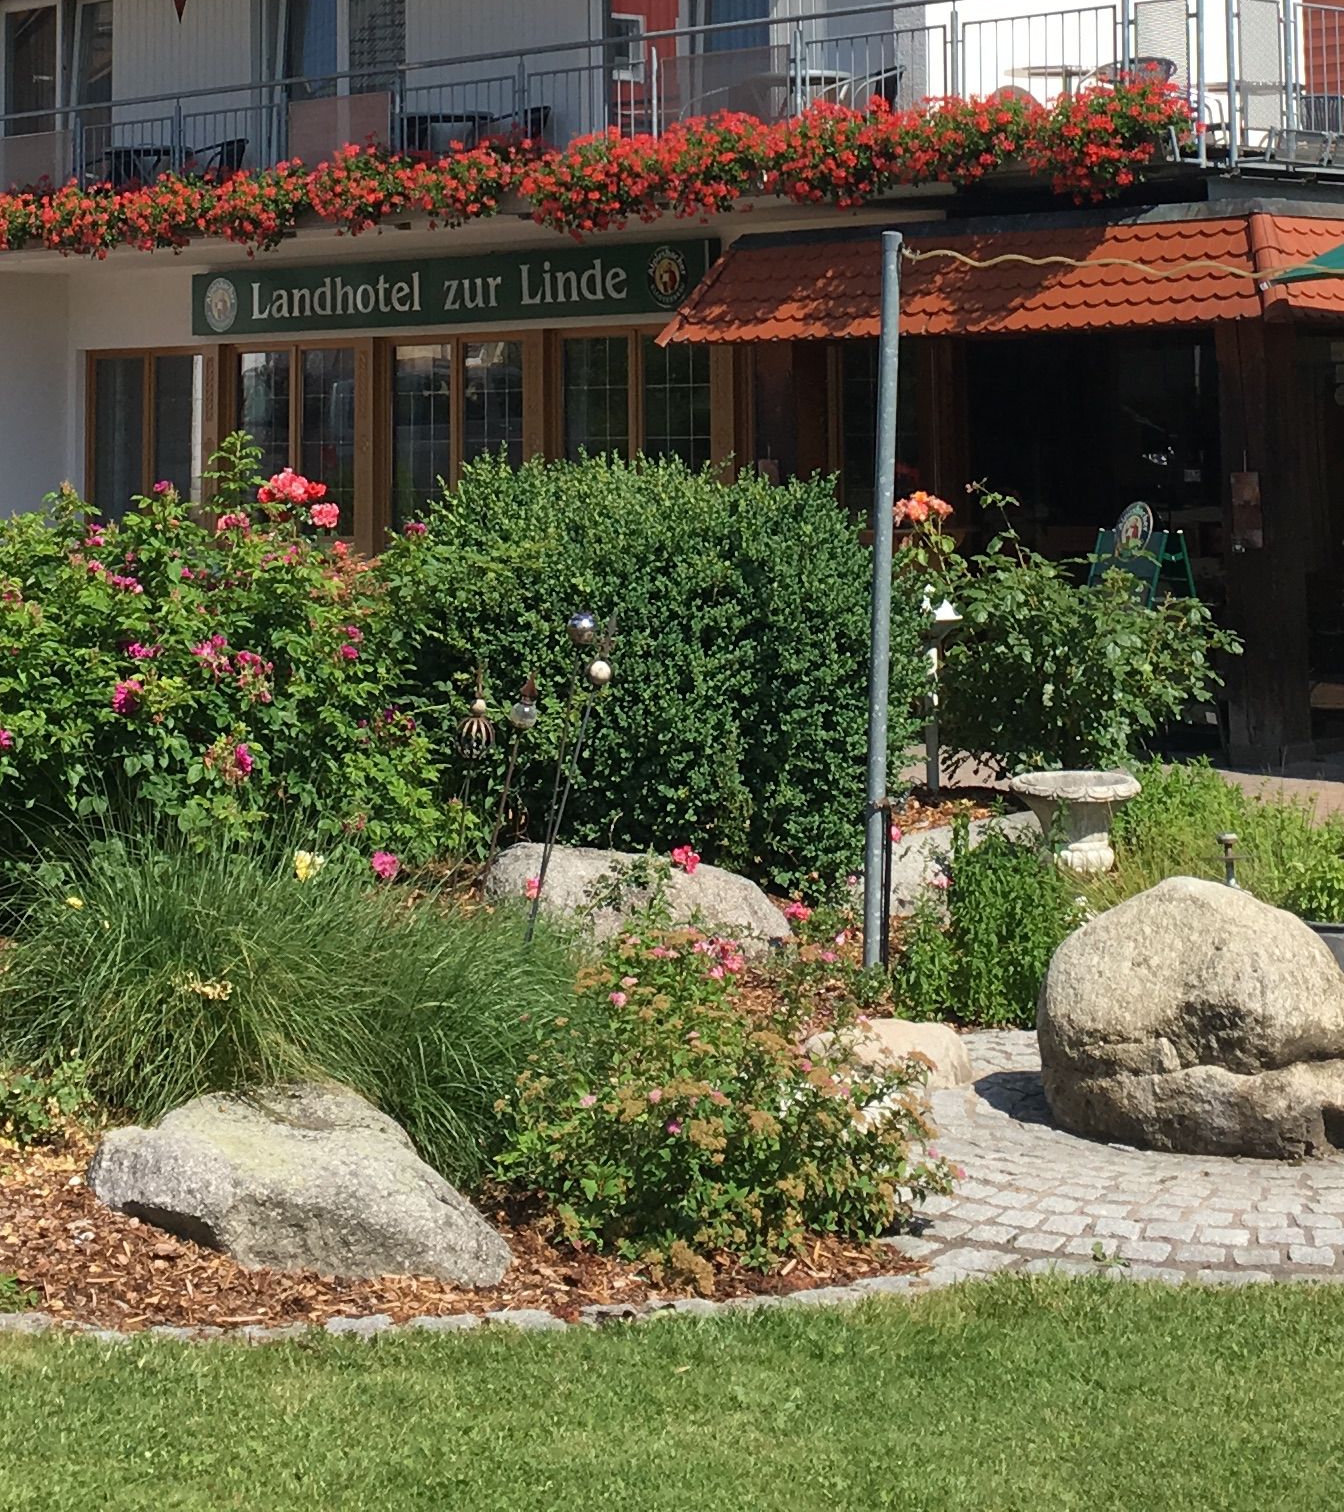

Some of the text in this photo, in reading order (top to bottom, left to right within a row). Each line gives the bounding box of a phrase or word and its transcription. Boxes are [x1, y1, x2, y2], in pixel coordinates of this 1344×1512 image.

[251, 272, 422, 321] Landhotel
[443, 273, 503, 311] zur
[520, 258, 628, 305] Linde
